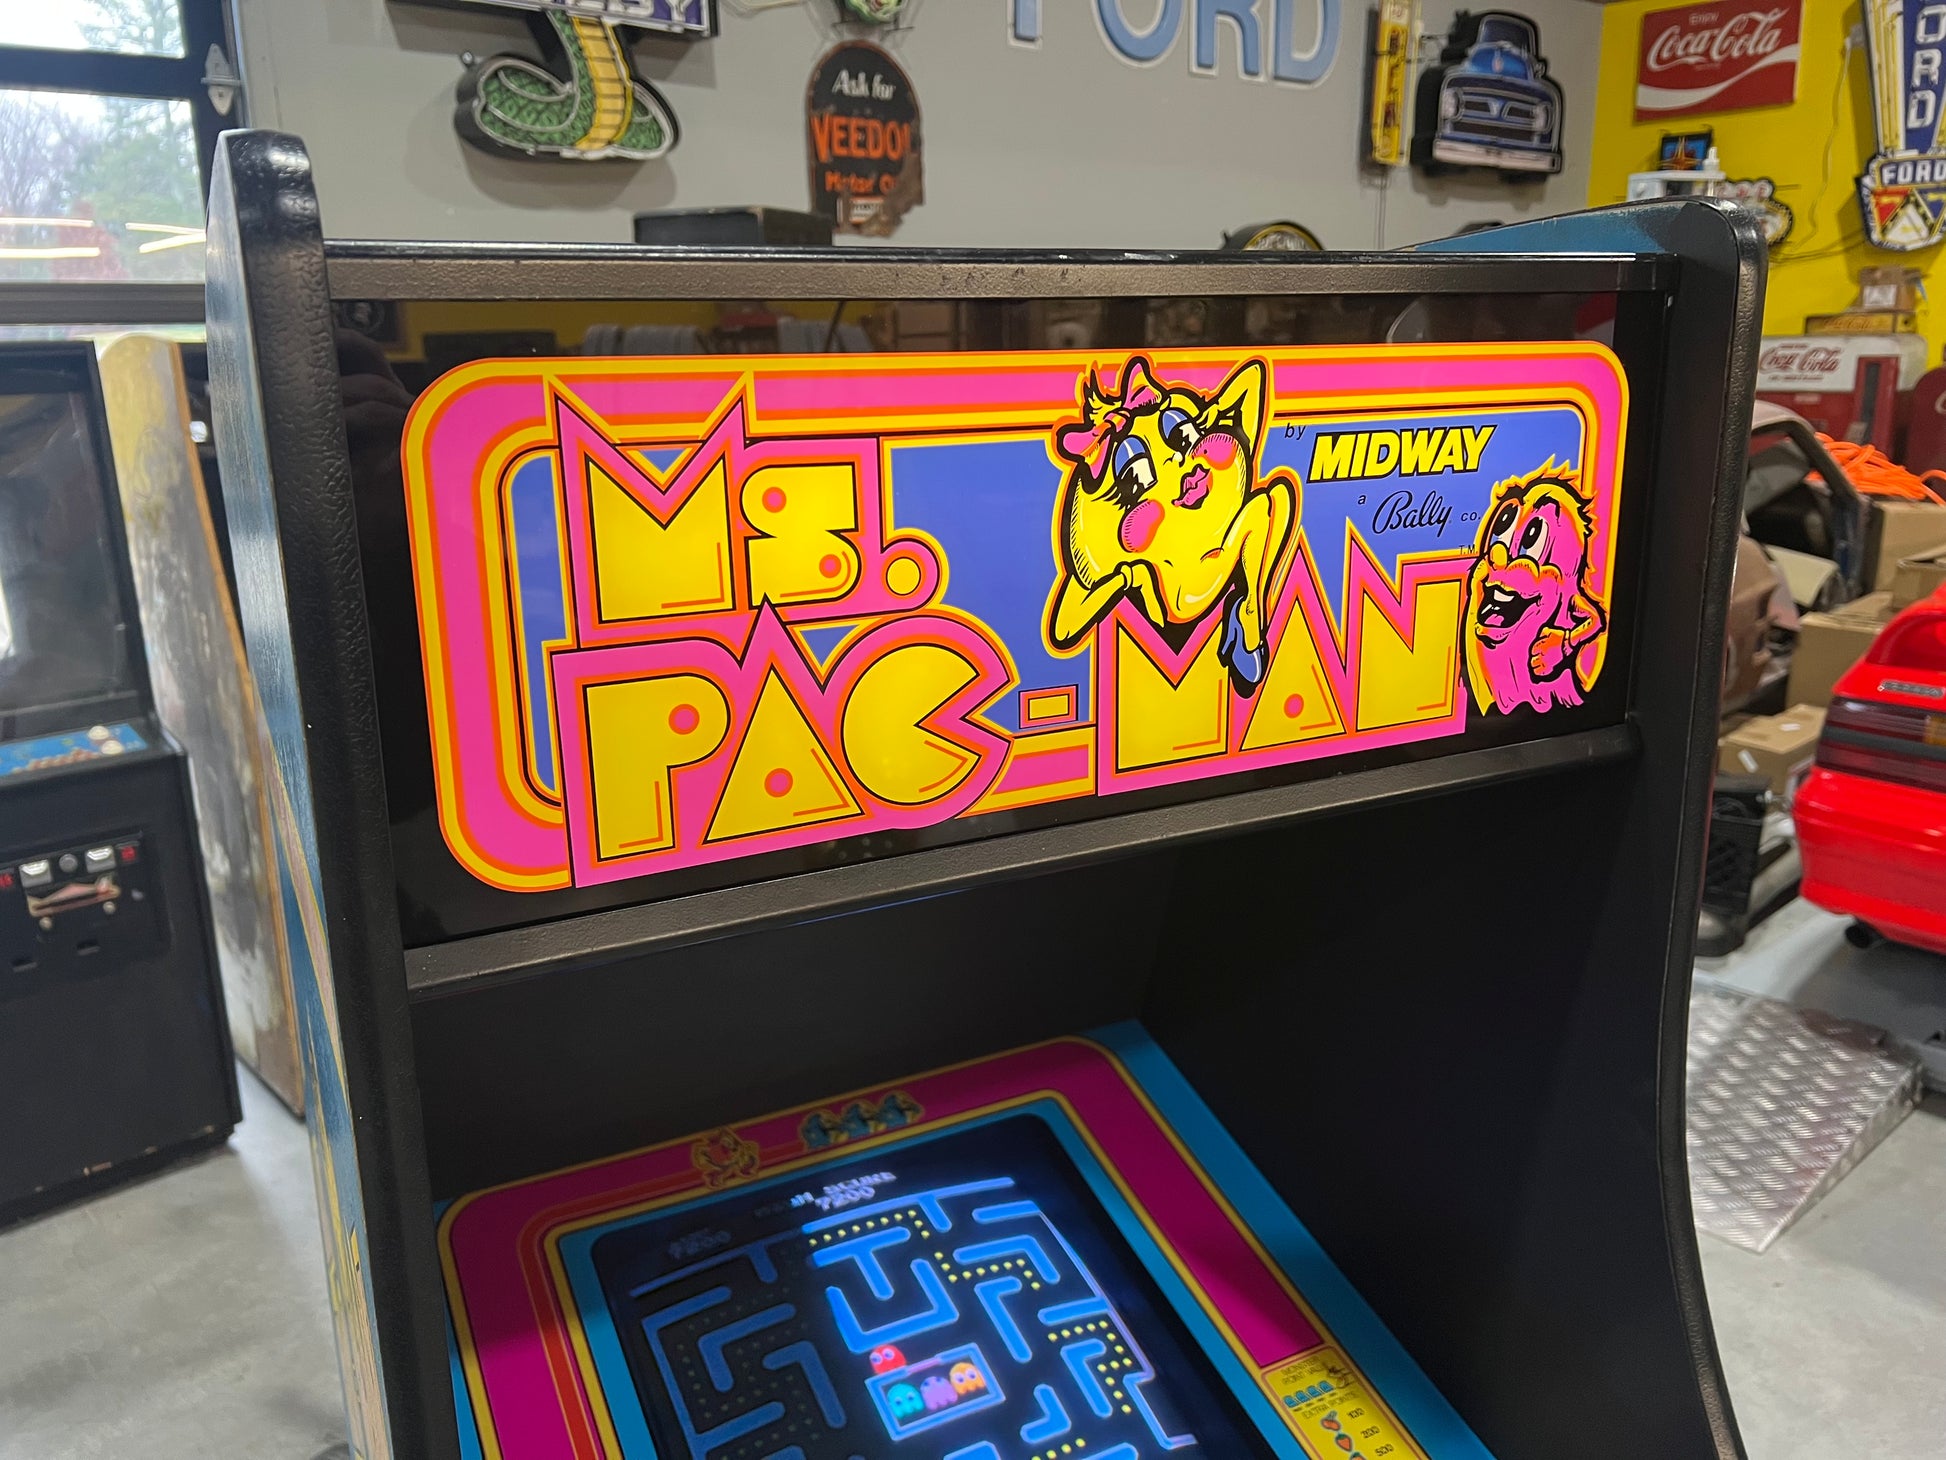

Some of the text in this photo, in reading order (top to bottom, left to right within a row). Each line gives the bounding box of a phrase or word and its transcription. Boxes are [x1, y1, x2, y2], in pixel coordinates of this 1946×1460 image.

[1647, 8, 1790, 72] Coca-Cola
[1908, 0, 1946, 129] ORD
[832, 69, 897, 101] Ask for
[1882, 160, 1946, 186] FORD
[1284, 422, 1498, 484] by MIDWAY
[1357, 490, 1482, 537] a Bally co.
[578, 572, 1466, 866] PAC-MAN
